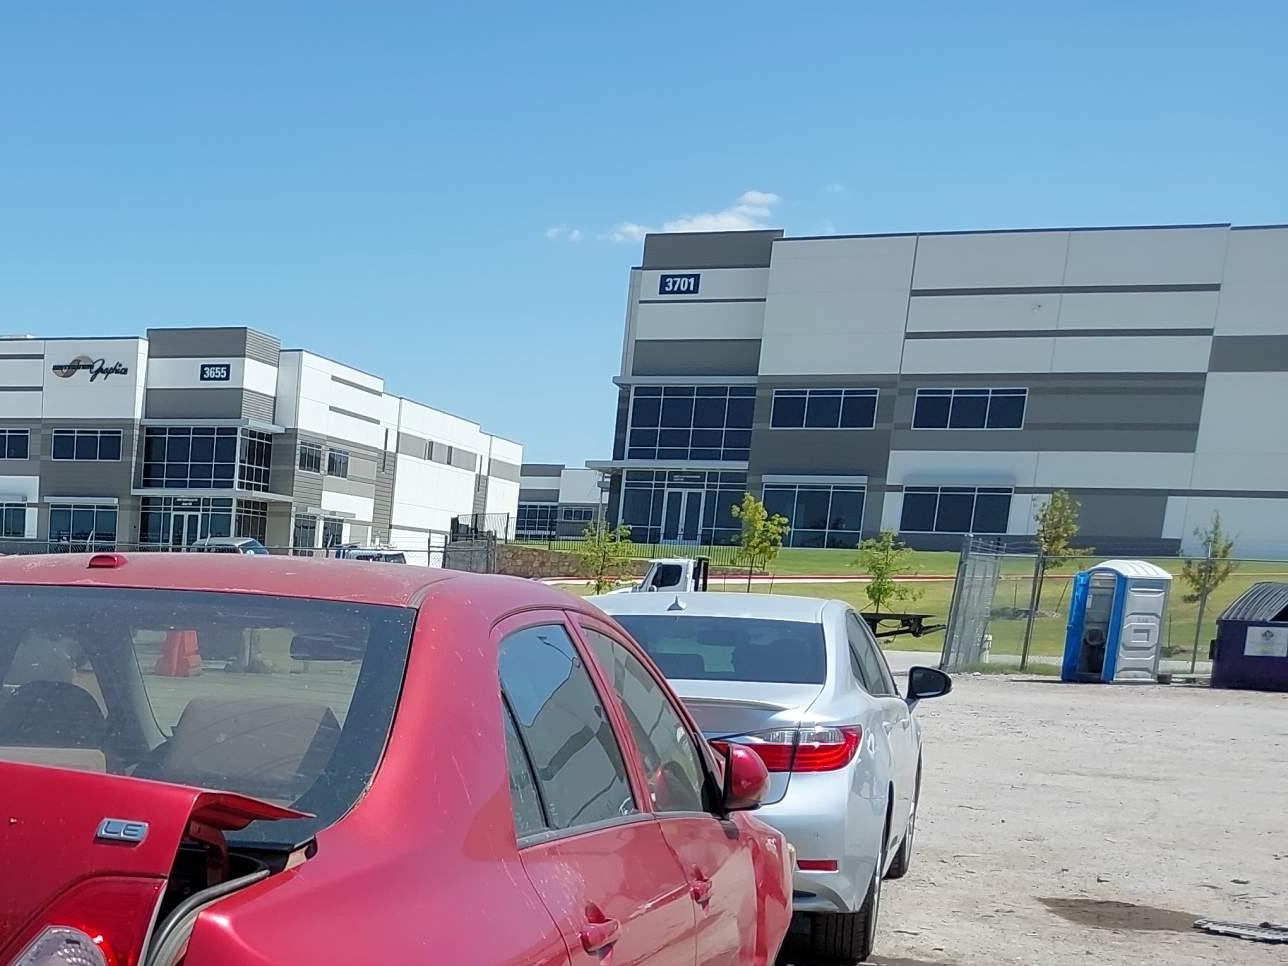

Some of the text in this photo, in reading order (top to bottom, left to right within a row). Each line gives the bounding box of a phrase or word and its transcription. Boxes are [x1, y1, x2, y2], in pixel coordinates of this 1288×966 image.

[664, 277, 696, 292] 3701
[202, 366, 228, 379] 3655
[97, 817, 149, 842] LE
